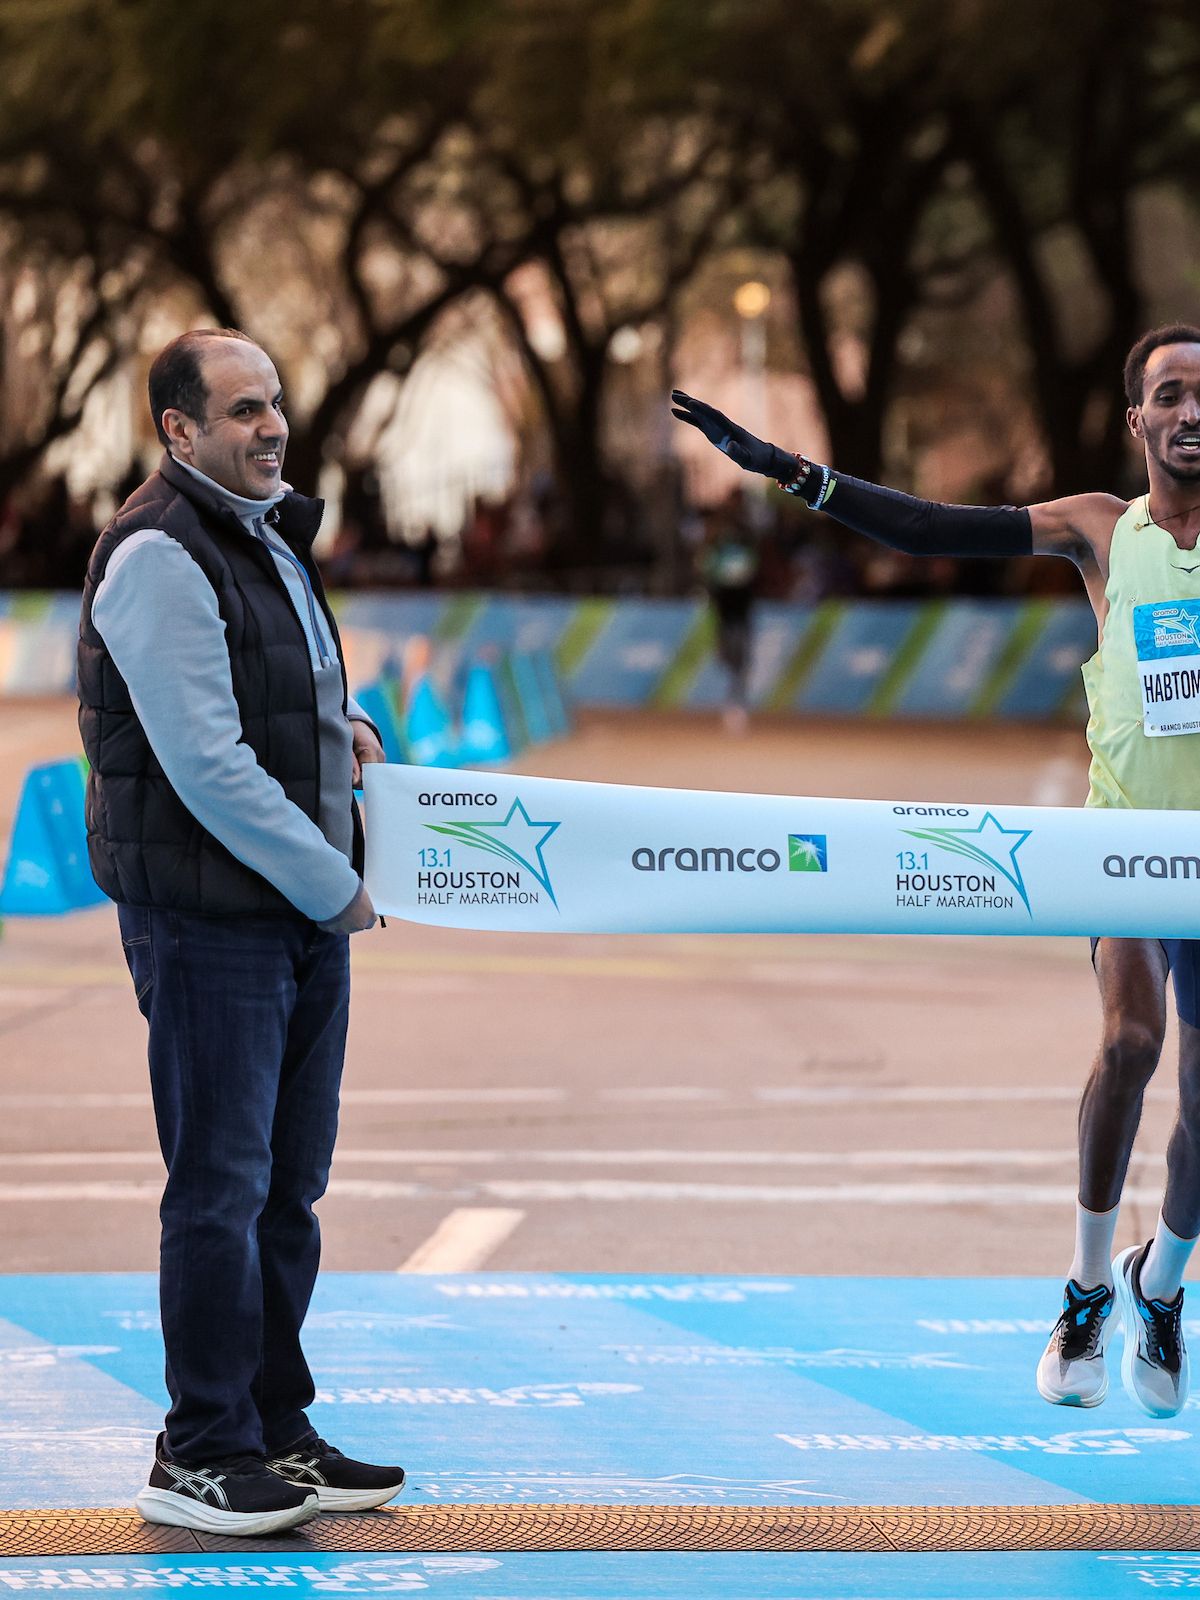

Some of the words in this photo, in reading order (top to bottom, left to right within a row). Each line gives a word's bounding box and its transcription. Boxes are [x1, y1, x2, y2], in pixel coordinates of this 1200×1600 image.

[1156, 633, 1186, 642] HOUSTON
[1161, 723, 1181, 731] ARAMCO
[418, 793, 498, 806] aramco
[893, 806, 970, 817] aramco
[418, 848, 451, 867] 13.1
[632, 847, 781, 872] aramco
[896, 852, 928, 871] 13.1
[418, 871, 520, 889] HOUSTON
[896, 874, 995, 892] HOUSTON
[418, 892, 455, 905] HALF
[459, 892, 539, 905] MARATHON
[896, 894, 931, 907] HALF
[937, 895, 1013, 909] MARATHON
[0, 1566, 319, 1577] CHEVRON
[0, 1572, 428, 1585] HOUSTON
[9, 1581, 299, 1590] MARATHON
